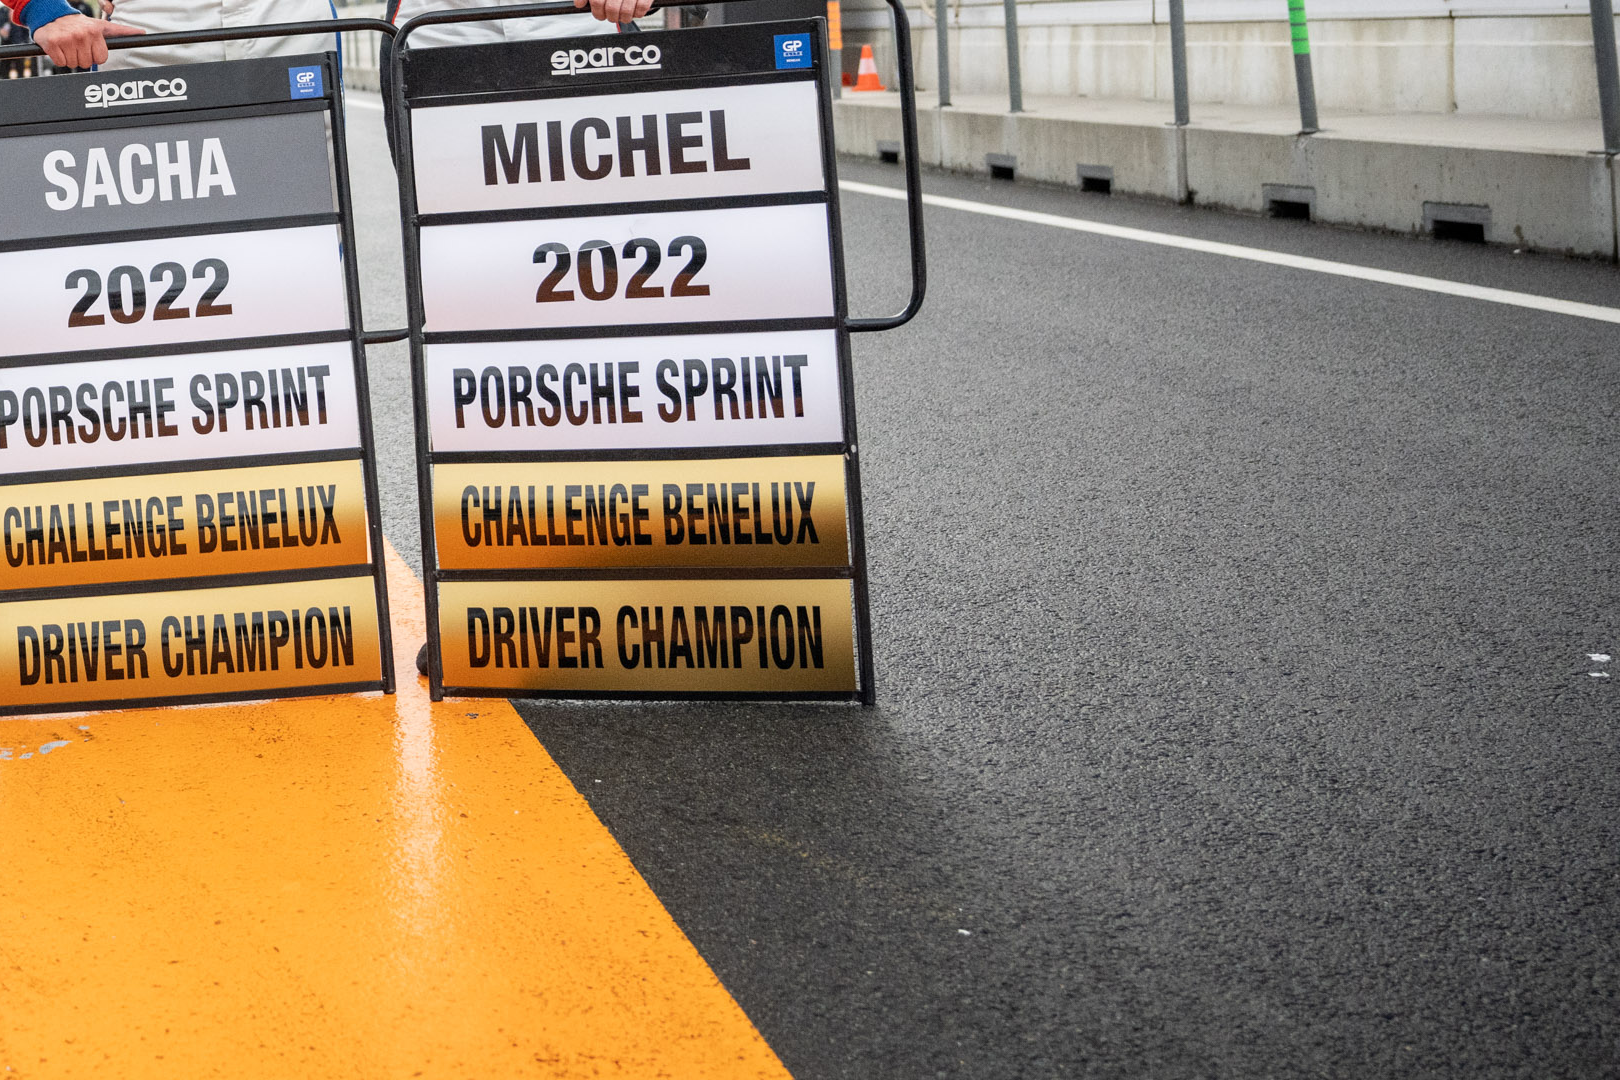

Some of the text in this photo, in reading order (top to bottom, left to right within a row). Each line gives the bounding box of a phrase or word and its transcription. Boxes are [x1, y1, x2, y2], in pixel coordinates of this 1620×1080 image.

[296, 72, 315, 83] GP
[550, 44, 662, 76] sparco
[782, 40, 803, 52] GP
[84, 77, 188, 109] sparco
[43, 137, 237, 211] SACHA
[481, 110, 751, 186] MICHEL
[65, 258, 233, 328] 2022
[533, 235, 711, 303] 2022
[190, 365, 331, 434] SPRINT
[454, 355, 809, 429] PORSCHE SPRINT
[4, 495, 185, 568] CHALLENGE
[196, 485, 340, 554] BENELUX
[461, 480, 821, 549] CHALLENGE BENELUX
[18, 607, 354, 686] DRIVER CHAMPION
[467, 604, 824, 671] DRIVER CHAMPION
